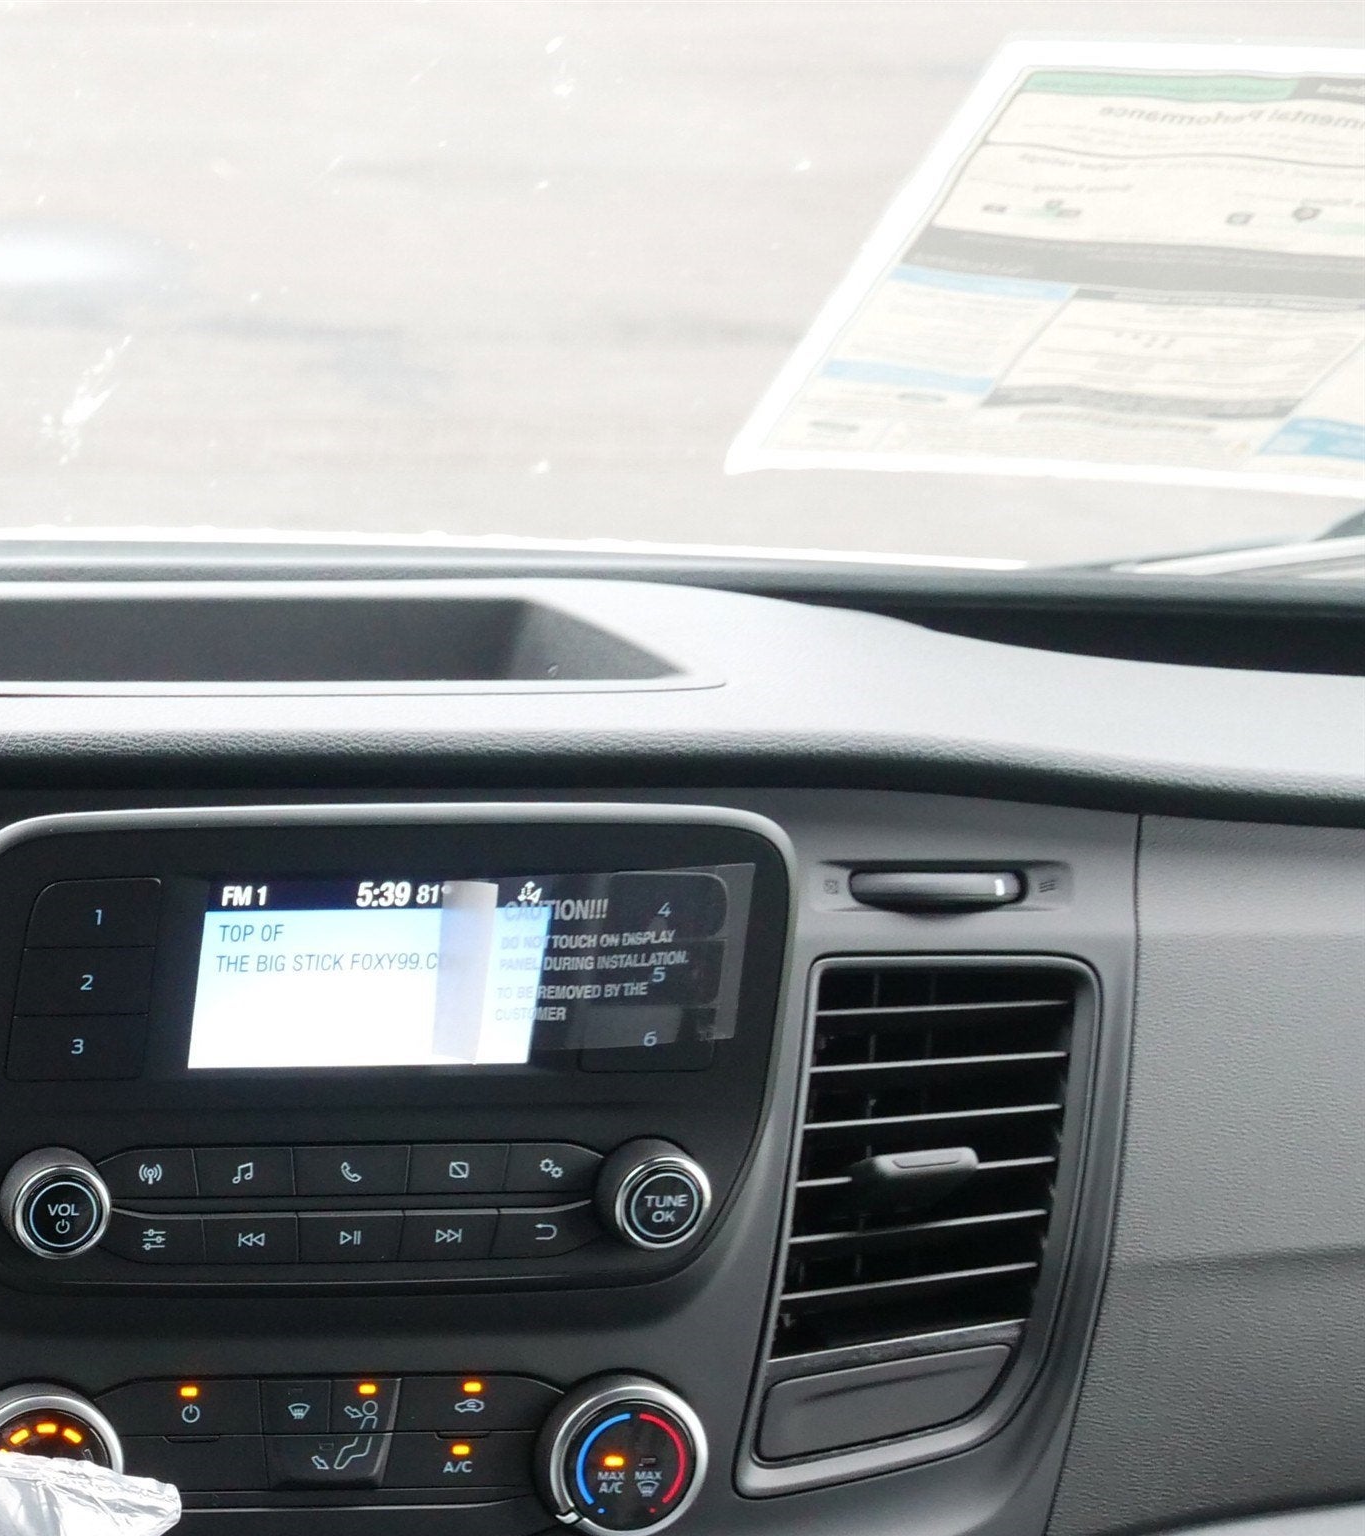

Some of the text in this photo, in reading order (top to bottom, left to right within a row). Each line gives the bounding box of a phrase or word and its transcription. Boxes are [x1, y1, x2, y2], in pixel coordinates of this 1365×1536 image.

[221, 886, 268, 907] FM 1
[356, 881, 411, 907] 5:39
[94, 909, 103, 925] 1
[504, 898, 609, 921] CAUTION!!!
[657, 901, 671, 918] 4
[219, 924, 285, 942] TOP OF
[500, 930, 676, 950] DO NOT TOUCH ON DISPLAY
[216, 955, 249, 972] THE
[256, 954, 285, 972] BIG
[292, 954, 343, 972] STICK
[499, 951, 689, 972] PANEL DURING INSTALLATION.
[80, 974, 94, 991] 2
[652, 966, 666, 983] 5
[496, 982, 649, 1000] TO BE REMOVED BY THE
[495, 1006, 566, 1022] CUSTOMER
[71, 1038, 85, 1055] 3
[643, 1031, 658, 1047] 6
[47, 1204, 80, 1217] VOL
[644, 1194, 689, 1210] TUNE
[652, 1210, 676, 1223] OK
[443, 1461, 473, 1474] A/C
[597, 1470, 626, 1482] MAX
[634, 1470, 663, 1482] MAX
[598, 1481, 623, 1494] A/C
